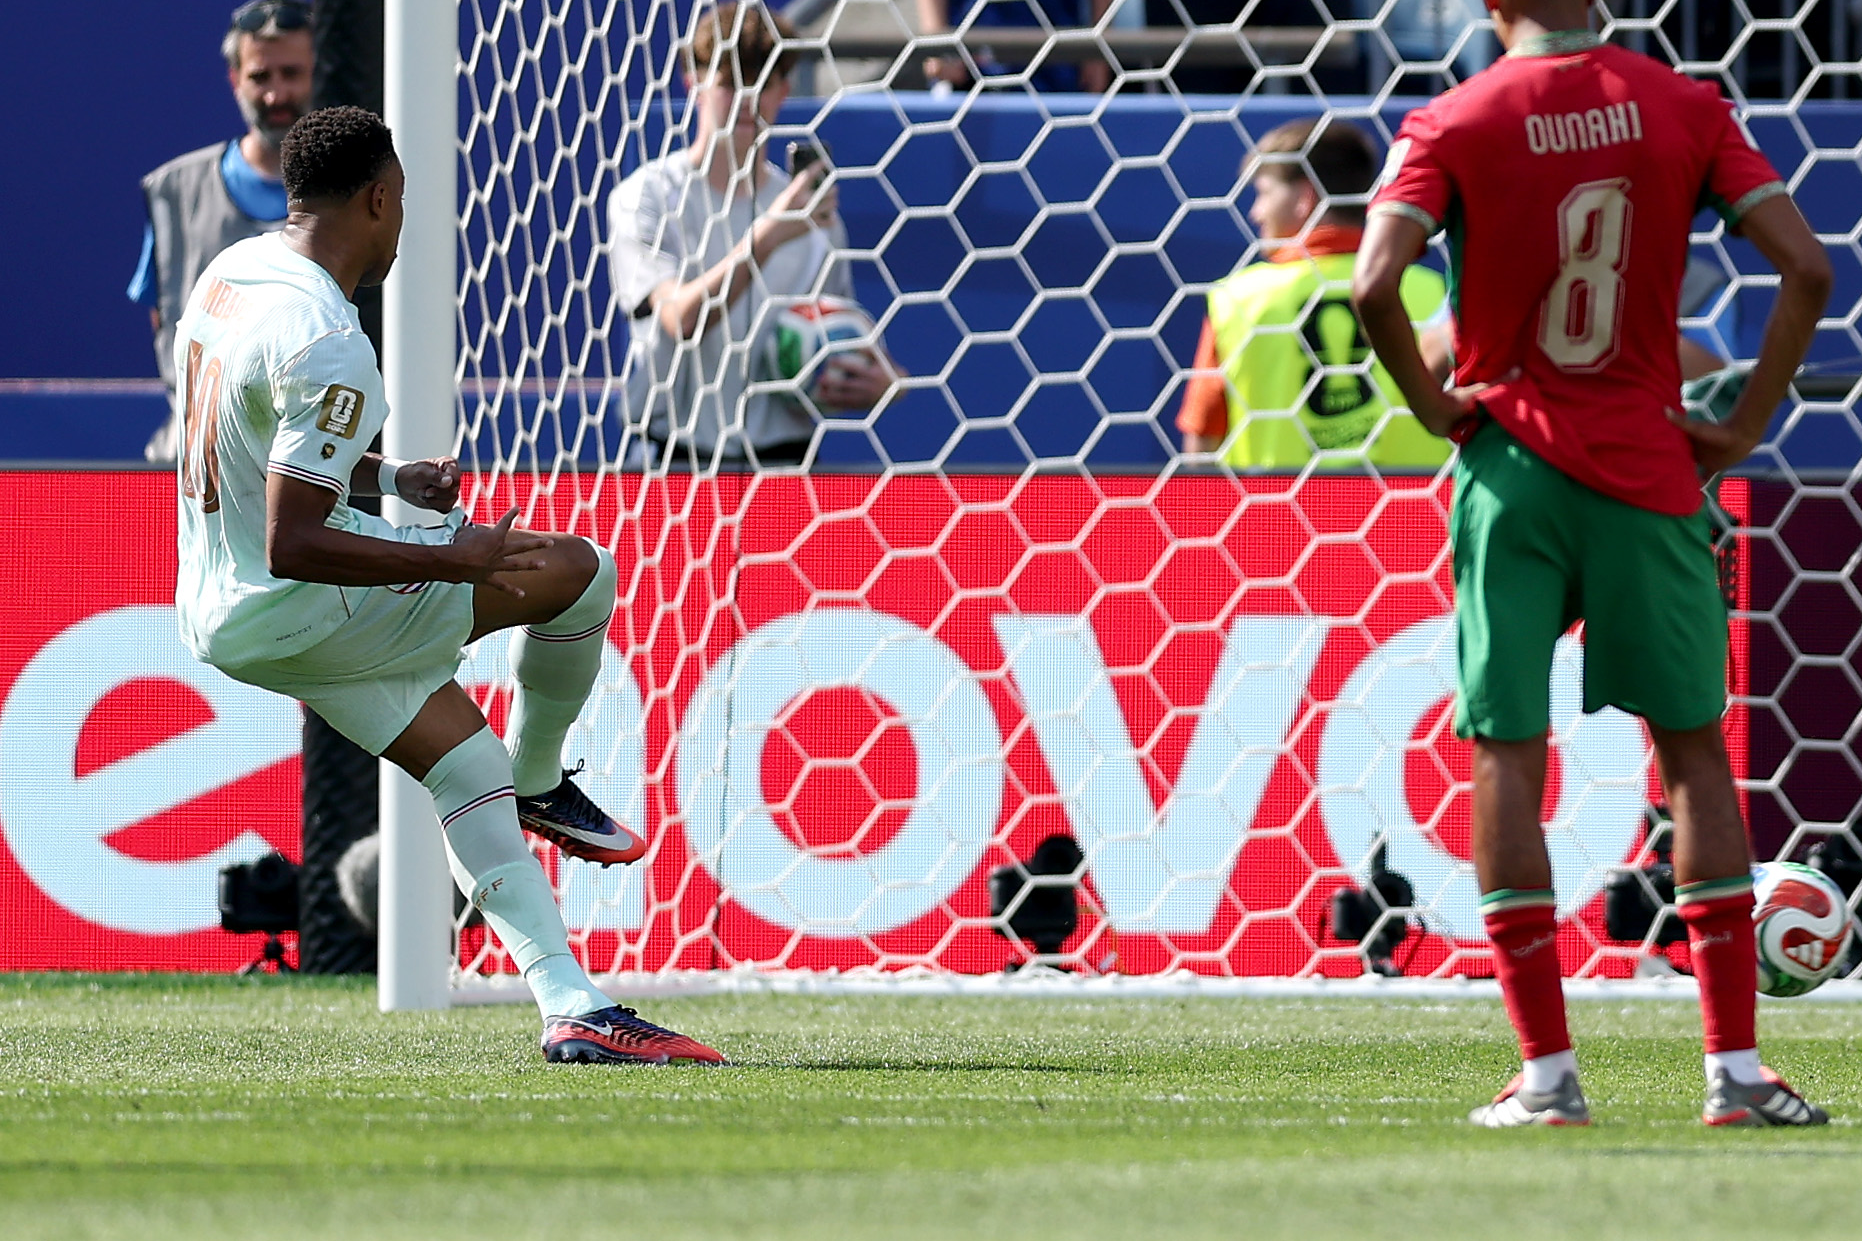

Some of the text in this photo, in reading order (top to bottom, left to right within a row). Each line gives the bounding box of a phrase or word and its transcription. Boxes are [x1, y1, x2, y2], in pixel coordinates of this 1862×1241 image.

[1525, 100, 1643, 156] OUNAHI
[1536, 175, 1634, 374] 8
[184, 338, 222, 514] 10
